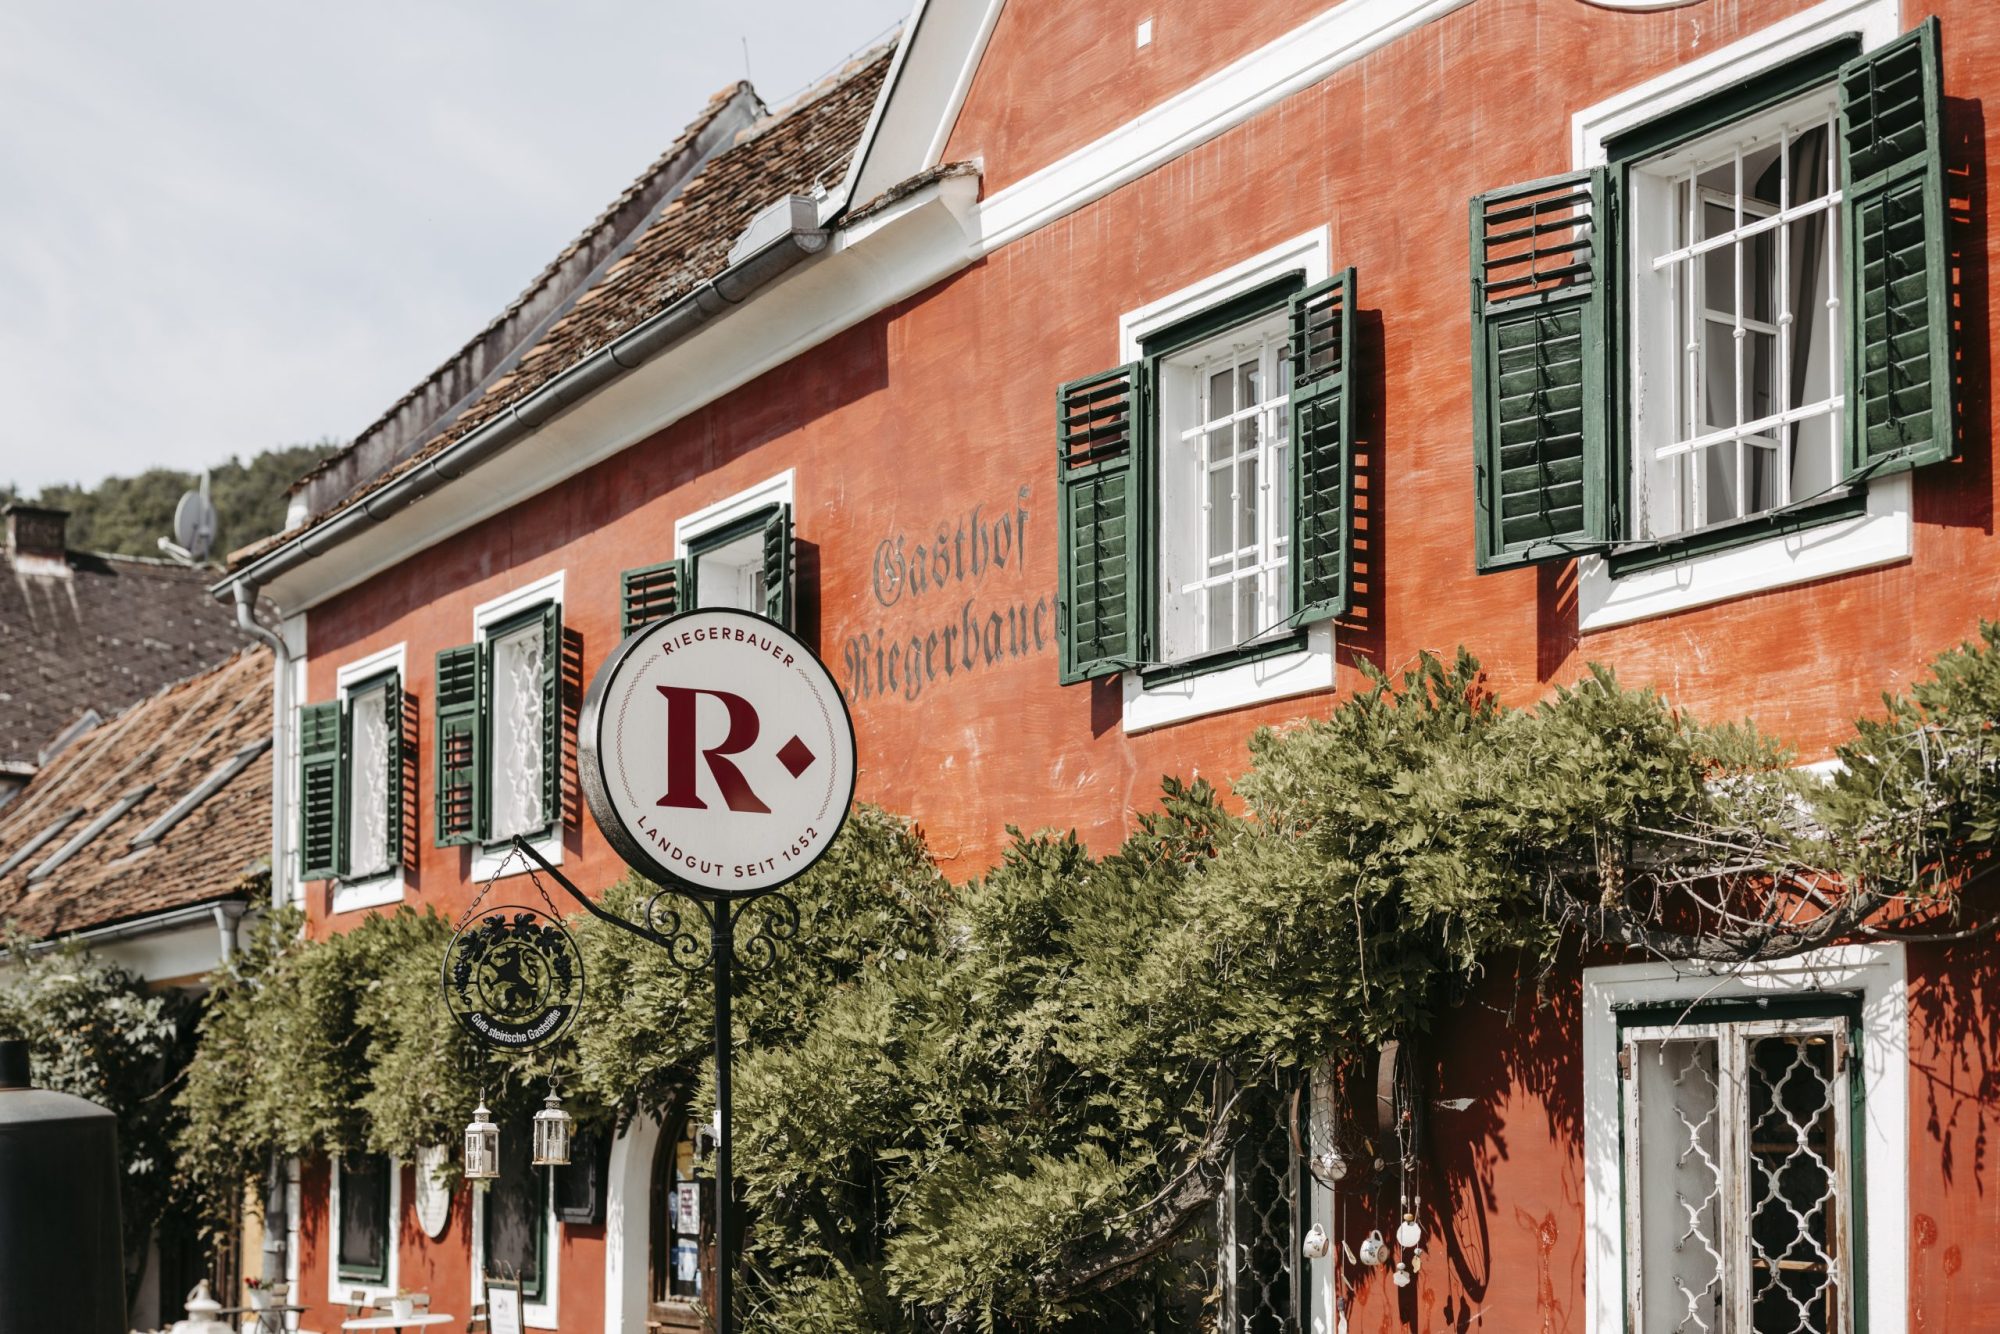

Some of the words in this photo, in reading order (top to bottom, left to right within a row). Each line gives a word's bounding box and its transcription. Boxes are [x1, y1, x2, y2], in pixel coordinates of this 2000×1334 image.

[873, 484, 1030, 608] Gasthof
[662, 627, 794, 668] RIEGERBAUER
[656, 685, 772, 814] R
[637, 815, 724, 877] LANDGUT
[734, 857, 776, 878] SEIT
[782, 827, 818, 862] 1652
[471, 1012, 489, 1033] Gute
[487, 1027, 528, 1043] steirische
[527, 1009, 561, 1040] Gaststätte
